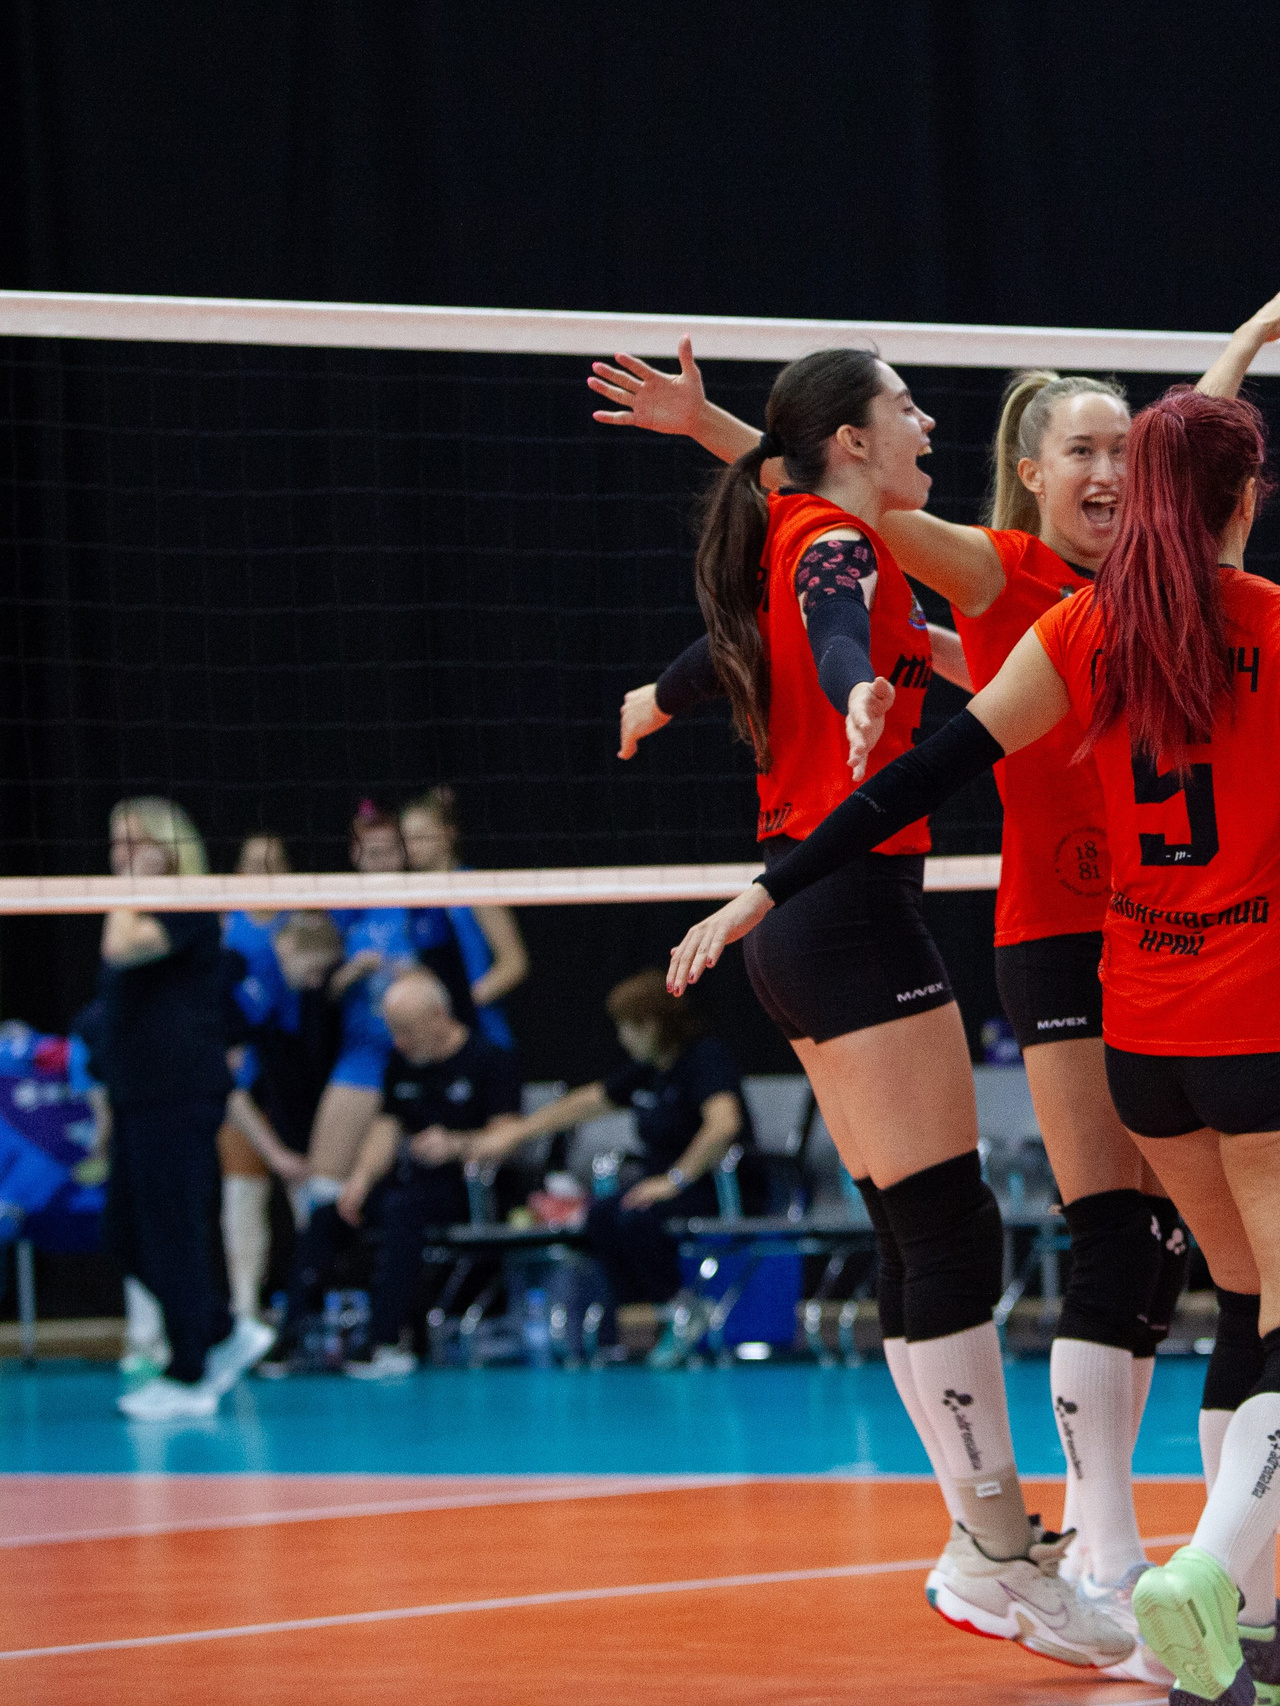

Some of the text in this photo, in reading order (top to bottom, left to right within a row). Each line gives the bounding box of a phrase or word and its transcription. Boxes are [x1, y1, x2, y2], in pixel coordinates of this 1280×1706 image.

[1130, 720, 1220, 866] 5
[1076, 840, 1098, 860] 18
[1079, 861, 1100, 880] 81
[1110, 892, 1270, 929] АБАРОВСКИЙ
[1138, 929, 1206, 956] КРАЙ
